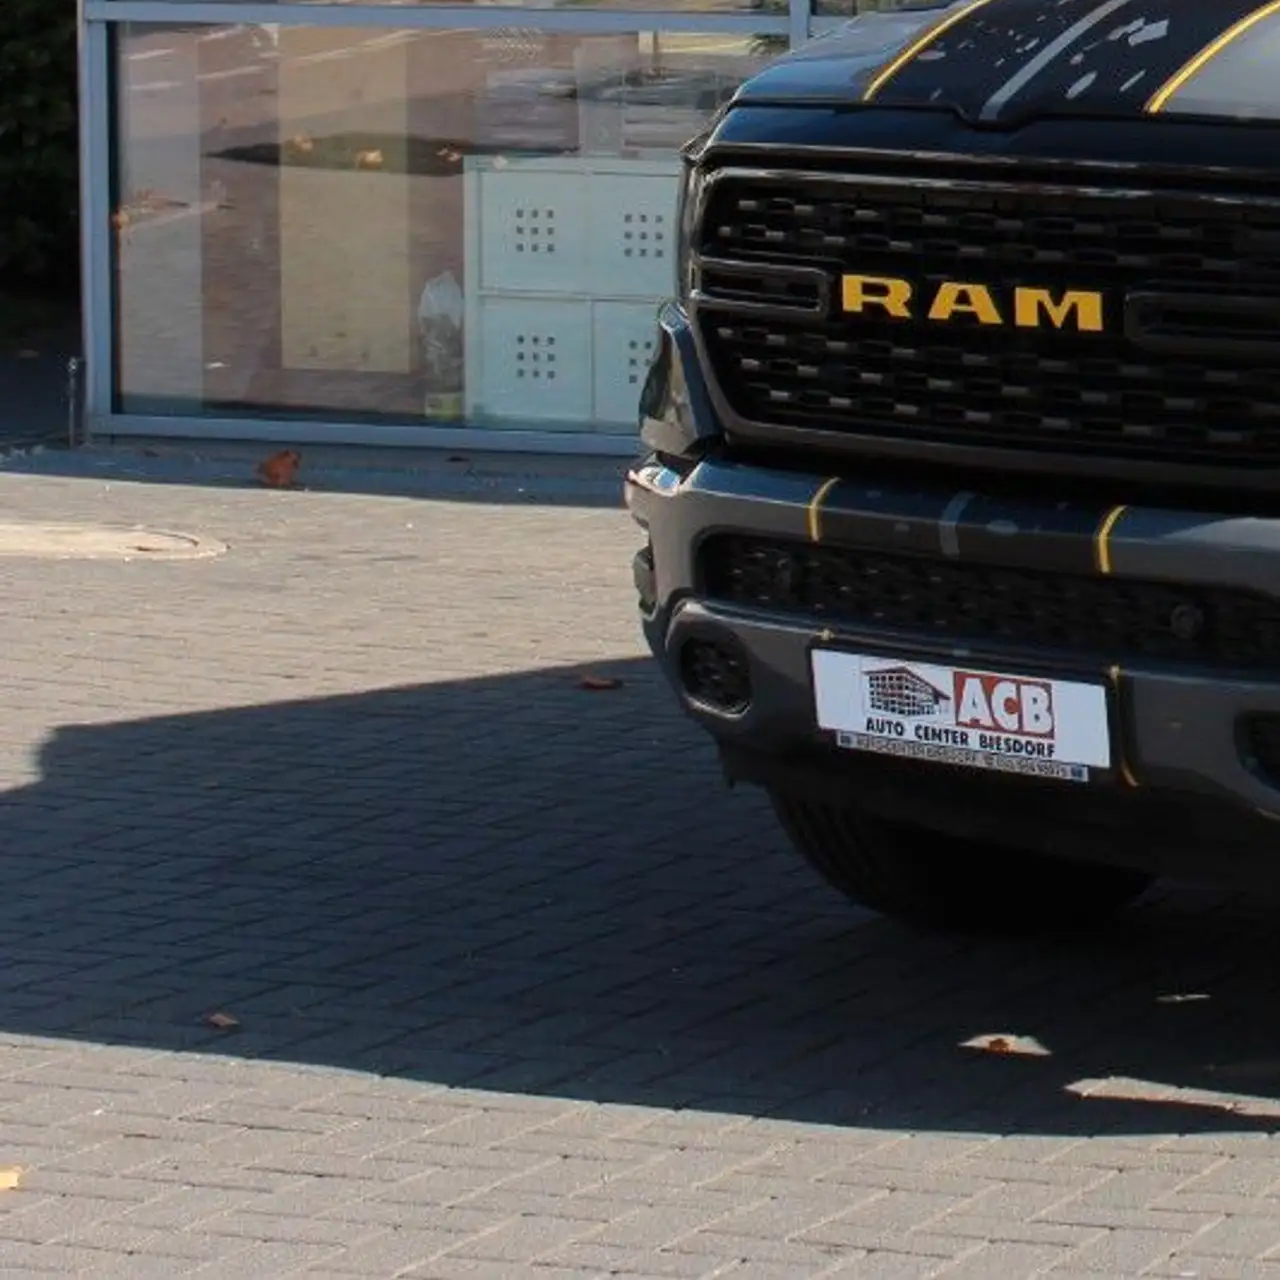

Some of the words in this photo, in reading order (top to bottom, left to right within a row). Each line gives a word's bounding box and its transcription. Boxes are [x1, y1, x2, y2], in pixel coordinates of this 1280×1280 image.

[841, 273, 1104, 332] RAM
[956, 676, 1053, 735] ACB
[866, 716, 905, 737] AUTO
[914, 723, 969, 746] CENTER
[979, 733, 1056, 759] BIESDORF
